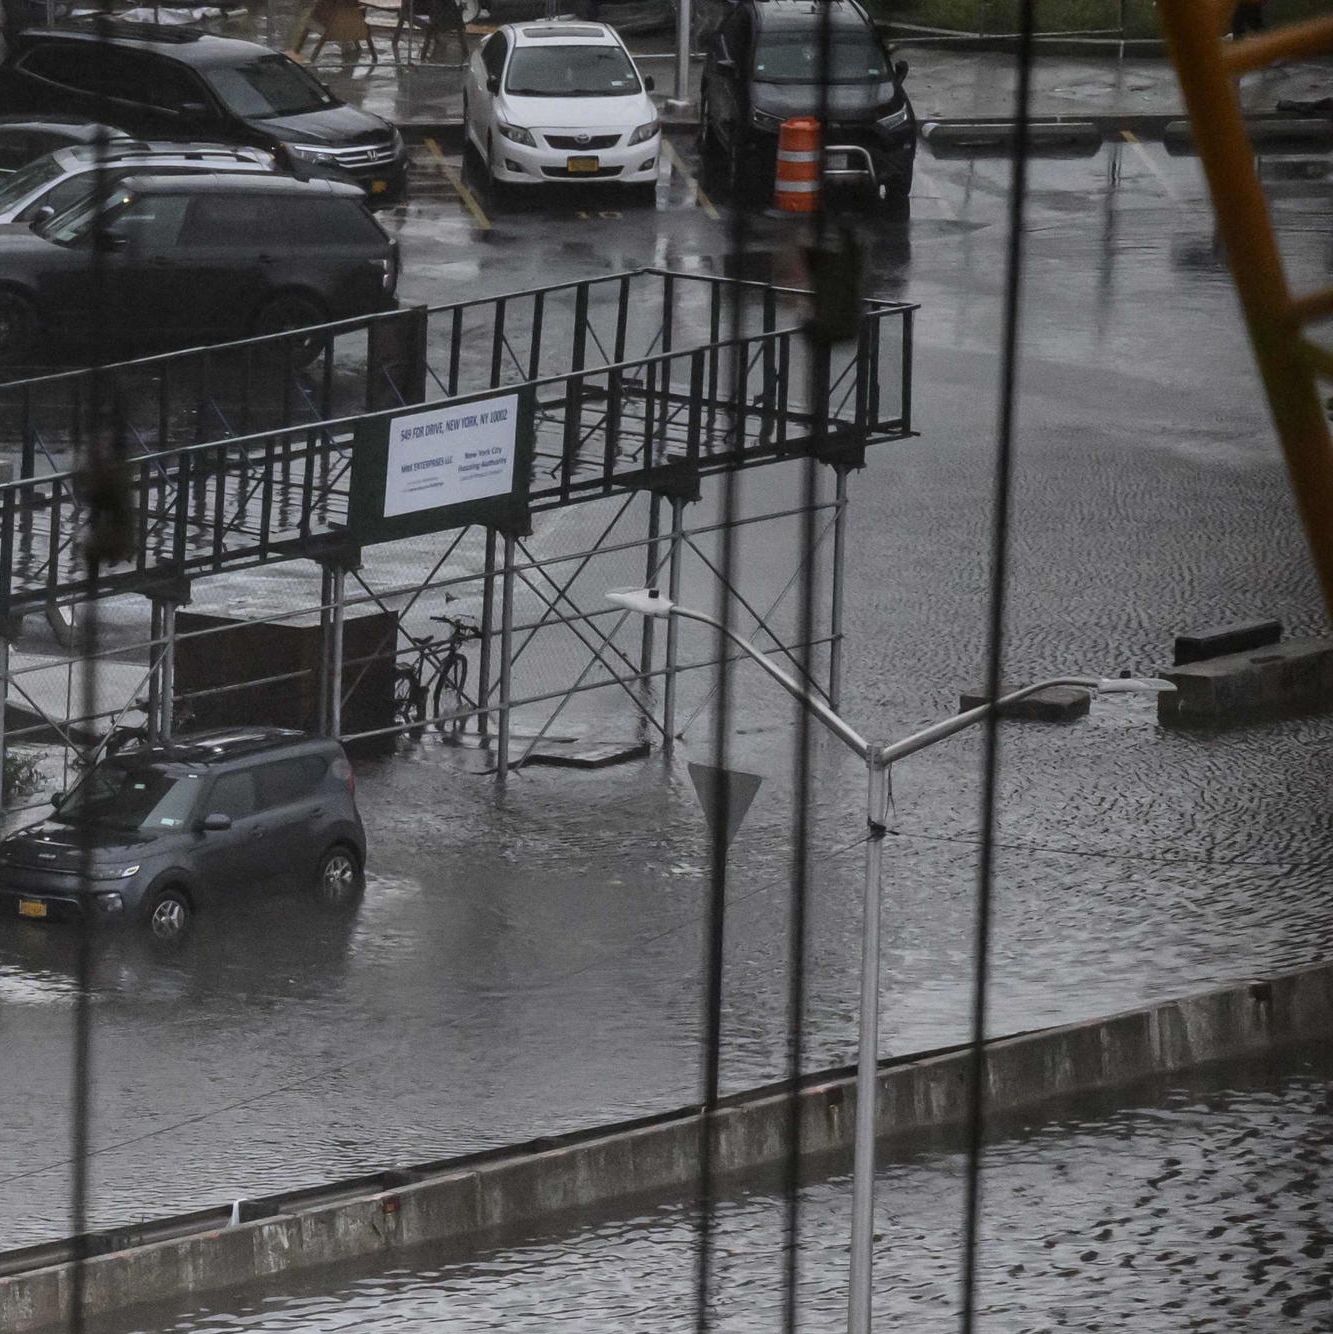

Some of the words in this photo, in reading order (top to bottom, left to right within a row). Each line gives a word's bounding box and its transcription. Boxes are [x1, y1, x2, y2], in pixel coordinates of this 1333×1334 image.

[425, 421, 444, 437] DRIVE,
[446, 419, 461, 432] NEW
[461, 415, 479, 429] YORK,
[480, 412, 489, 426] NY
[489, 408, 508, 424] 10002
[479, 449, 490, 457] York
[491, 447, 502, 455] City
[458, 463, 480, 472] Housing
[481, 457, 508, 468] Authority
